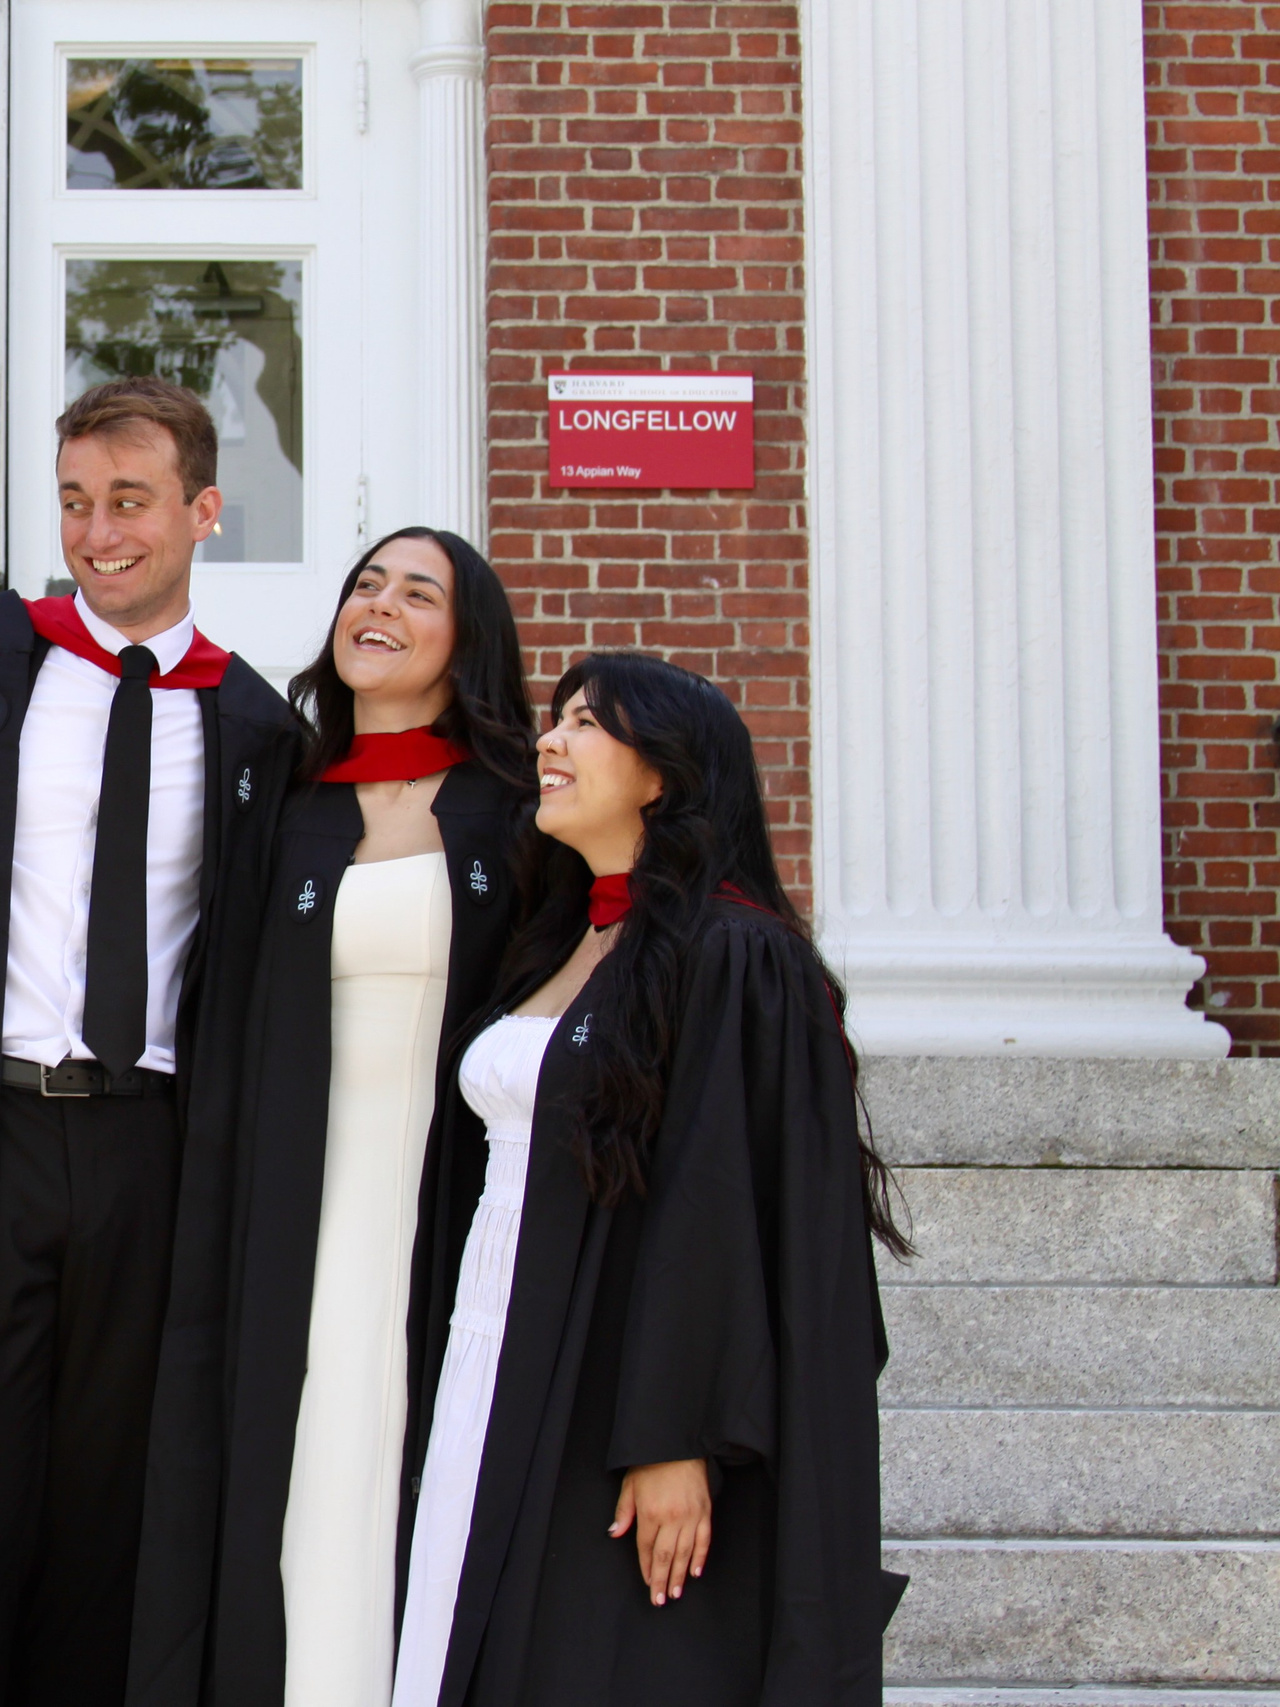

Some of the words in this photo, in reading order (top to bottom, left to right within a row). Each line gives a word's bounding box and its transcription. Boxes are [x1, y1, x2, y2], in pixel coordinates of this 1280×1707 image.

[571, 380, 625, 388] HARVARD
[558, 409, 738, 432] LONGFELLOW
[560, 466, 574, 477] 13
[576, 466, 614, 479] Appian
[616, 466, 641, 480] Way
